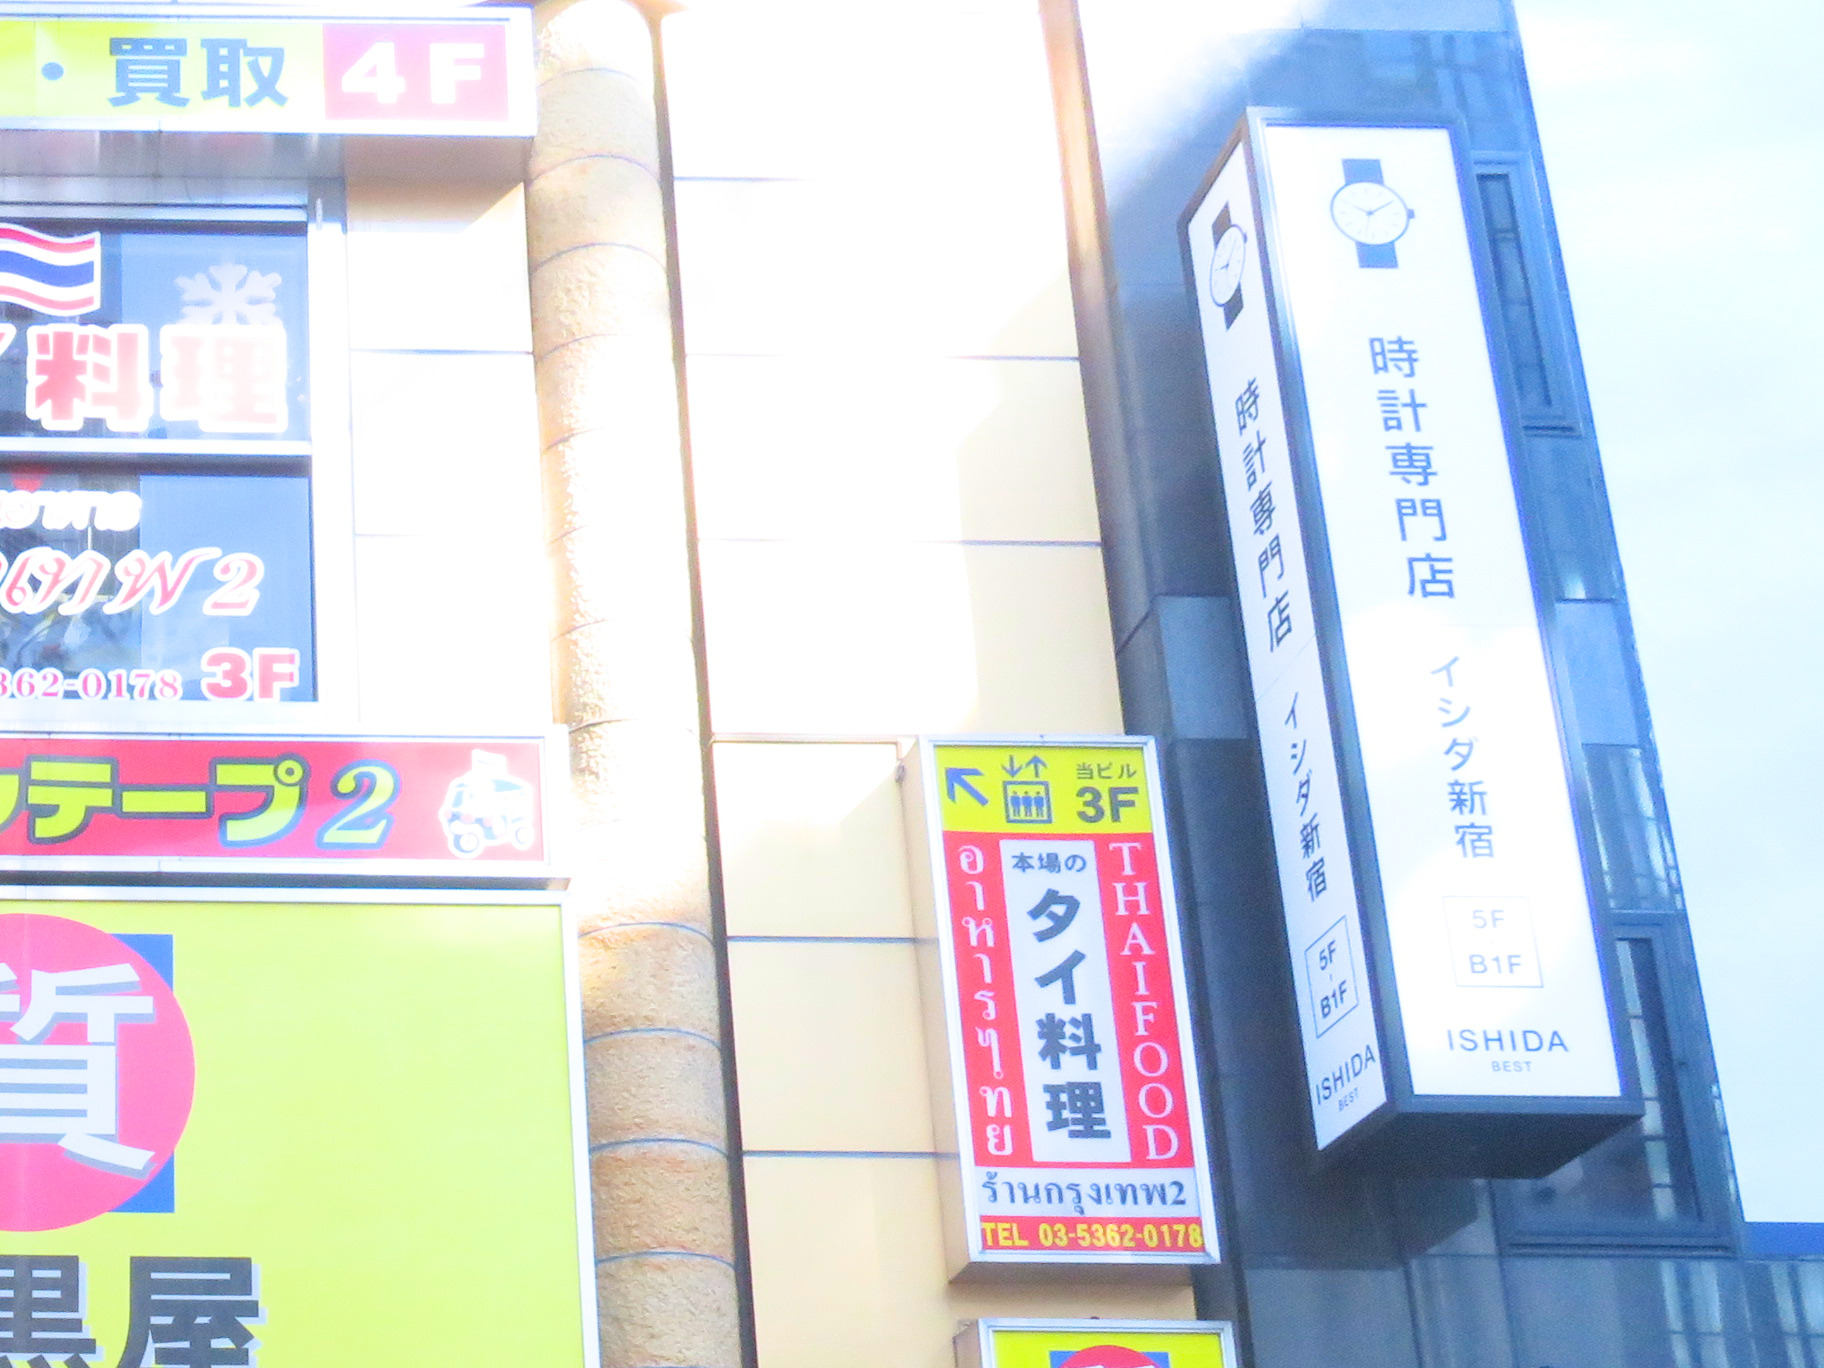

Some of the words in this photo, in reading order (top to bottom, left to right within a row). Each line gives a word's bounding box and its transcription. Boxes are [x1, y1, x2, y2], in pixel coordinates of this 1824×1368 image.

[340, 41, 486, 107] 4F
[1368, 334, 1456, 600] 時計専門店
[1234, 375, 1294, 654] 時計専門店
[203, 554, 265, 616] 2
[201, 648, 299, 700] 3F
[1075, 761, 1139, 781] 当ビル
[1430, 655, 1495, 860] イシダ新宿
[317, 760, 404, 850] 2
[1075, 785, 1140, 824] 3F
[1283, 691, 1329, 903] イシダ新宿
[1011, 851, 1087, 874] 本場の
[1472, 909, 1505, 929] 5F
[1318, 940, 1338, 972] 5F
[1468, 953, 1522, 975] B1F
[1026, 886, 1112, 1141] タイ料理
[1319, 979, 1349, 1019] B1F
[1447, 1028, 1569, 1053] ISHIDA
[1315, 1043, 1377, 1106] ISHIDA
[1491, 1060, 1533, 1073] BEST
[981, 1220, 1030, 1248] TEL
[1038, 1222, 1204, 1250] 03-5362-0178
